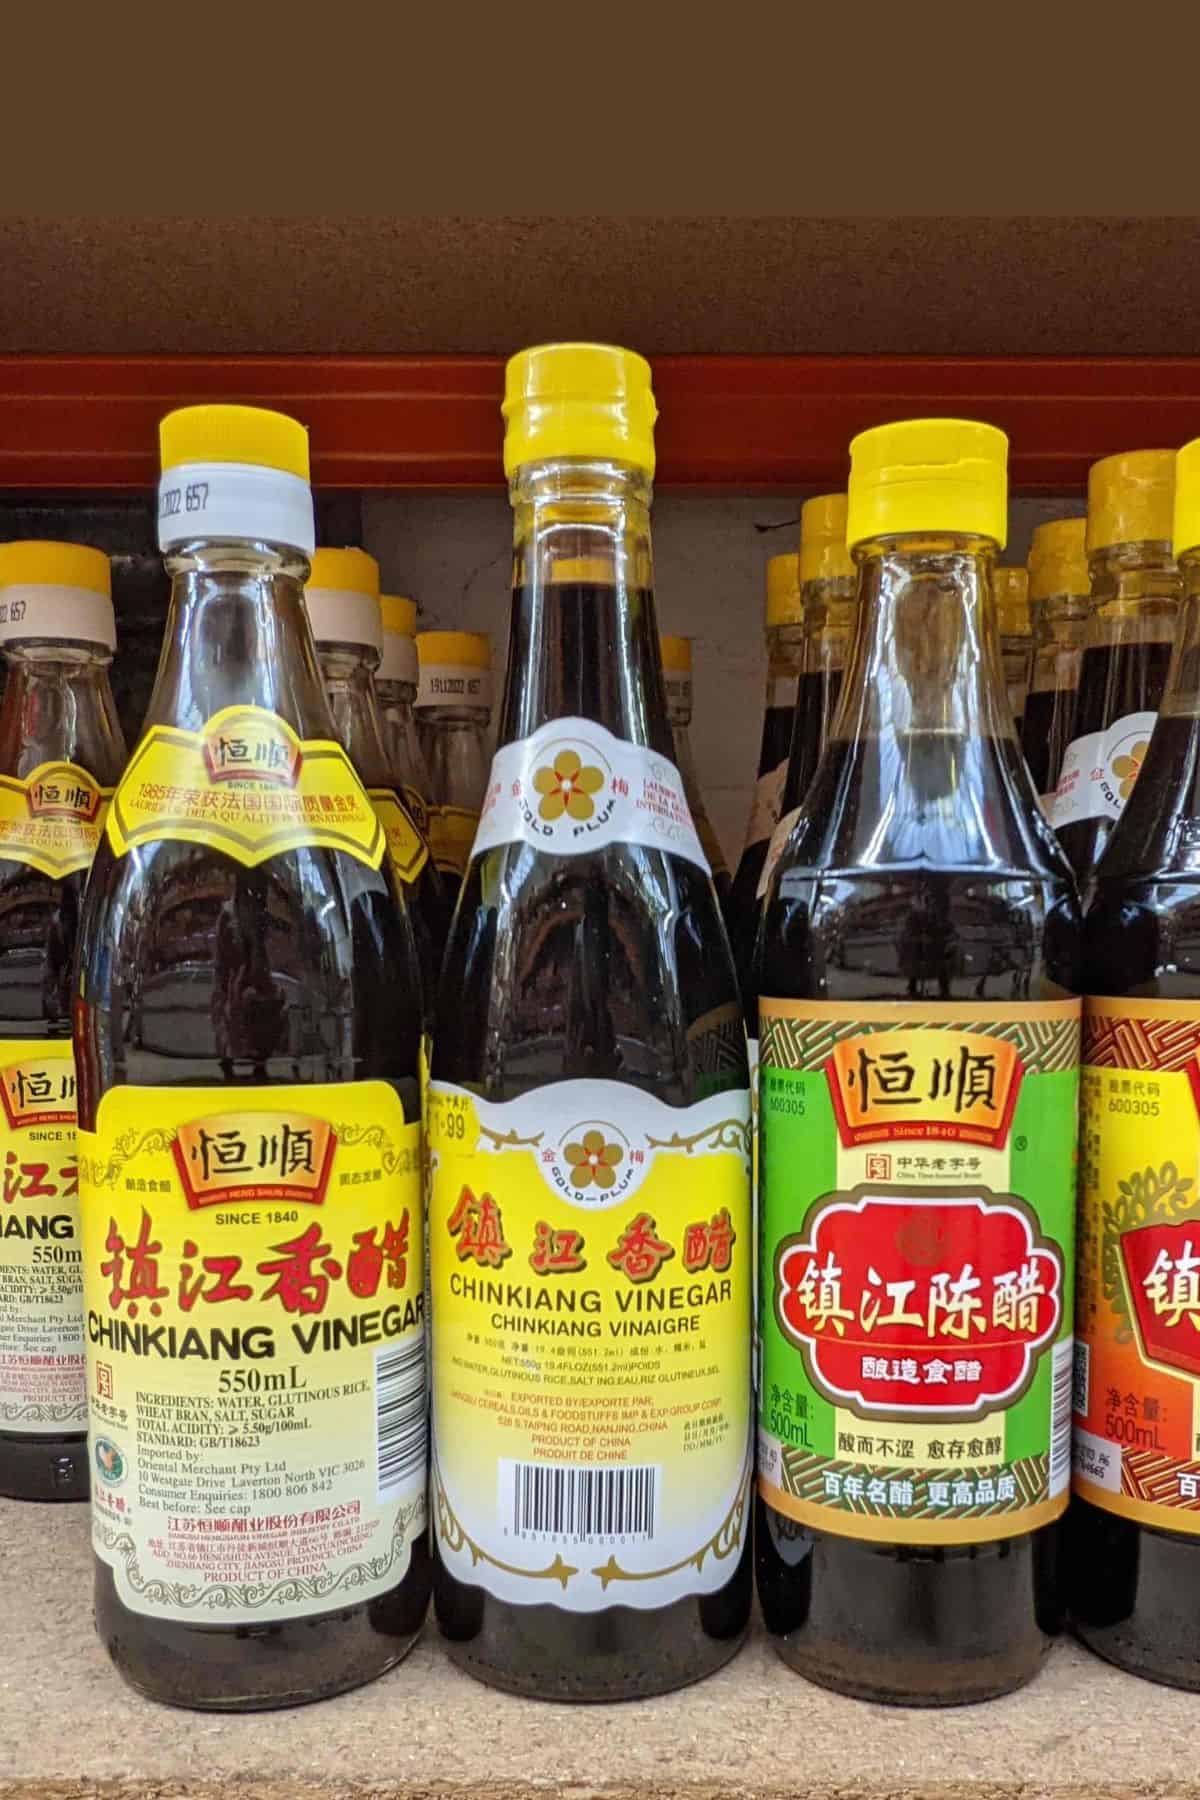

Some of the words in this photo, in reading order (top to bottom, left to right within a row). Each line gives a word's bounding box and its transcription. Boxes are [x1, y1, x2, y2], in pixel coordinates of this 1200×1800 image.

[186, 483, 209, 512] 657
[1100, 782, 1121, 808] GOL
[1108, 1100, 1160, 1117] 600305
[29, 1131, 63, 1142] SINCE
[215, 1212, 261, 1226] SINCE
[266, 1210, 299, 1224] 1840
[32, 1245, 83, 1264] 550m
[57, 1275, 83, 1284] SUGA
[449, 1272, 602, 1314] CHINKIANG
[614, 1278, 732, 1313] VINEGAR
[797, 1251, 1046, 1340] 镇江陈醋
[88, 1309, 276, 1361] CHINKIANG
[290, 1291, 424, 1355] VINEGAR
[490, 1312, 602, 1338] CHINKIANG
[608, 1314, 701, 1338] VINAIGRE
[218, 1365, 308, 1394] 550mL
[861, 1355, 983, 1385] 酿造食醋
[136, 1391, 214, 1409] INGREDIENTS:
[268, 1387, 341, 1406] GLUTINOUS
[511, 1391, 564, 1407] EXPORTED
[136, 1404, 174, 1421] WHEAT
[250, 1406, 296, 1421] SUGAR
[550, 1409, 619, 1421] FOODSTUFFS
[137, 1417, 170, 1433] TOTAL
[770, 1410, 815, 1448] 500mL
[1105, 1413, 1166, 1450] 500mL
[199, 1435, 261, 1449] GB/T18623
[531, 1434, 581, 1447] PRODUCT
[582, 1437, 597, 1447] OF
[599, 1436, 632, 1447] CHINA
[838, 1431, 915, 1459] 酸而不涩
[927, 1435, 1003, 1460] 愈存愈醇
[137, 1444, 182, 1460] Imported
[532, 1447, 577, 1460] PRODUIT
[579, 1449, 594, 1460] DE
[596, 1448, 628, 1461] CHINE
[137, 1457, 178, 1473] Oriental
[181, 1462, 238, 1475] Merchant
[240, 1463, 261, 1476] Pty
[265, 1459, 287, 1473] Ltd
[196, 1475, 226, 1489] Drive
[231, 1474, 281, 1489] Laverton
[284, 1469, 316, 1485] North
[318, 1463, 341, 1478] VIC
[138, 1482, 187, 1500] Consumer
[252, 1485, 282, 1500] 1800
[285, 1484, 308, 1497] 806
[310, 1479, 334, 1493] 842
[822, 1470, 914, 1507] 百年名醋
[926, 1473, 1016, 1508] 更高品质
[138, 1496, 160, 1511] Best
[204, 1503, 227, 1514] See
[229, 1504, 252, 1517] cap
[203, 1571, 264, 1583] PRODUCT
[266, 1568, 285, 1580] OF
[287, 1561, 328, 1578] CHINA
